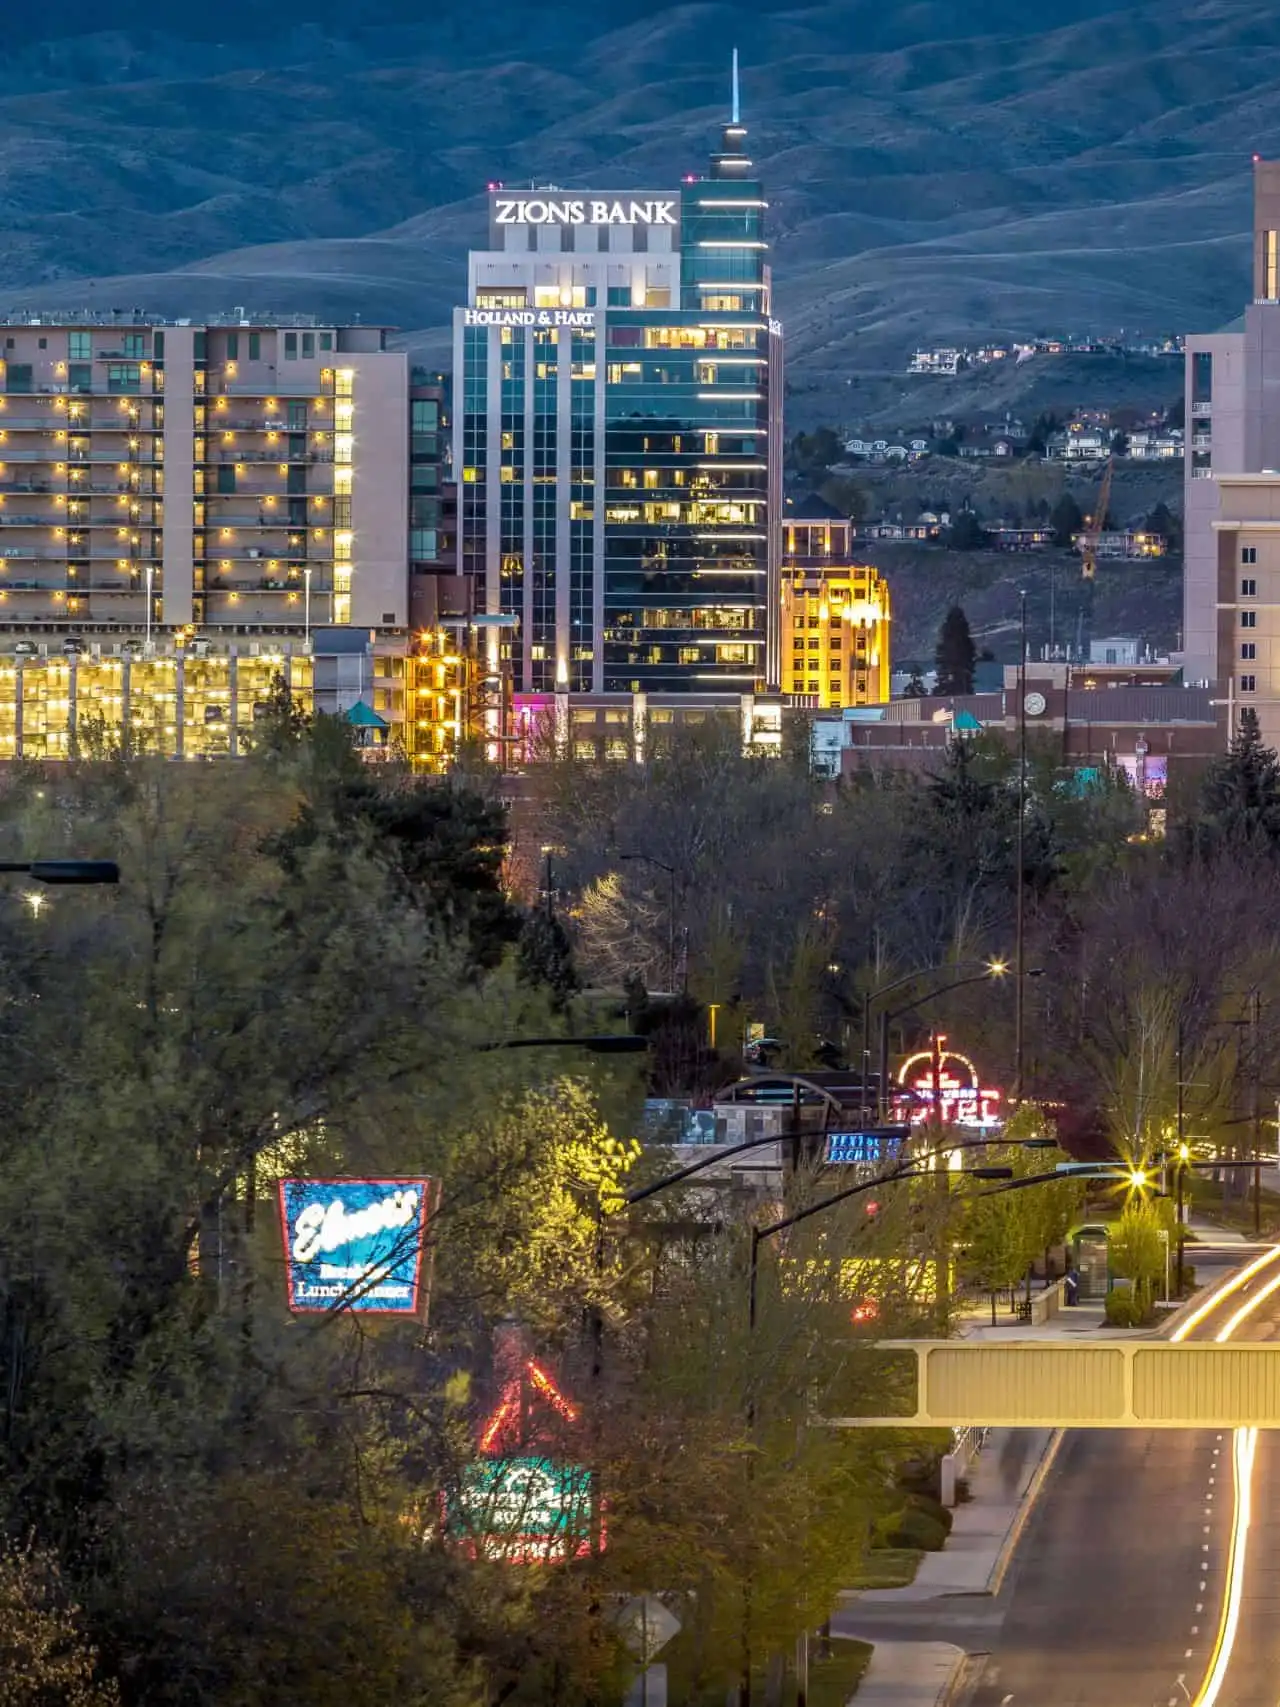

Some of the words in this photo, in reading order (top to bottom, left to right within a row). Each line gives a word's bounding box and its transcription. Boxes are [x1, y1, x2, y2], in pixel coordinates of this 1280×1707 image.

[495, 200, 585, 224] ZIONS
[591, 200, 677, 224] BANK
[464, 310, 534, 325] HOLLAND
[538, 310, 551, 325] &
[555, 311, 595, 326] HART
